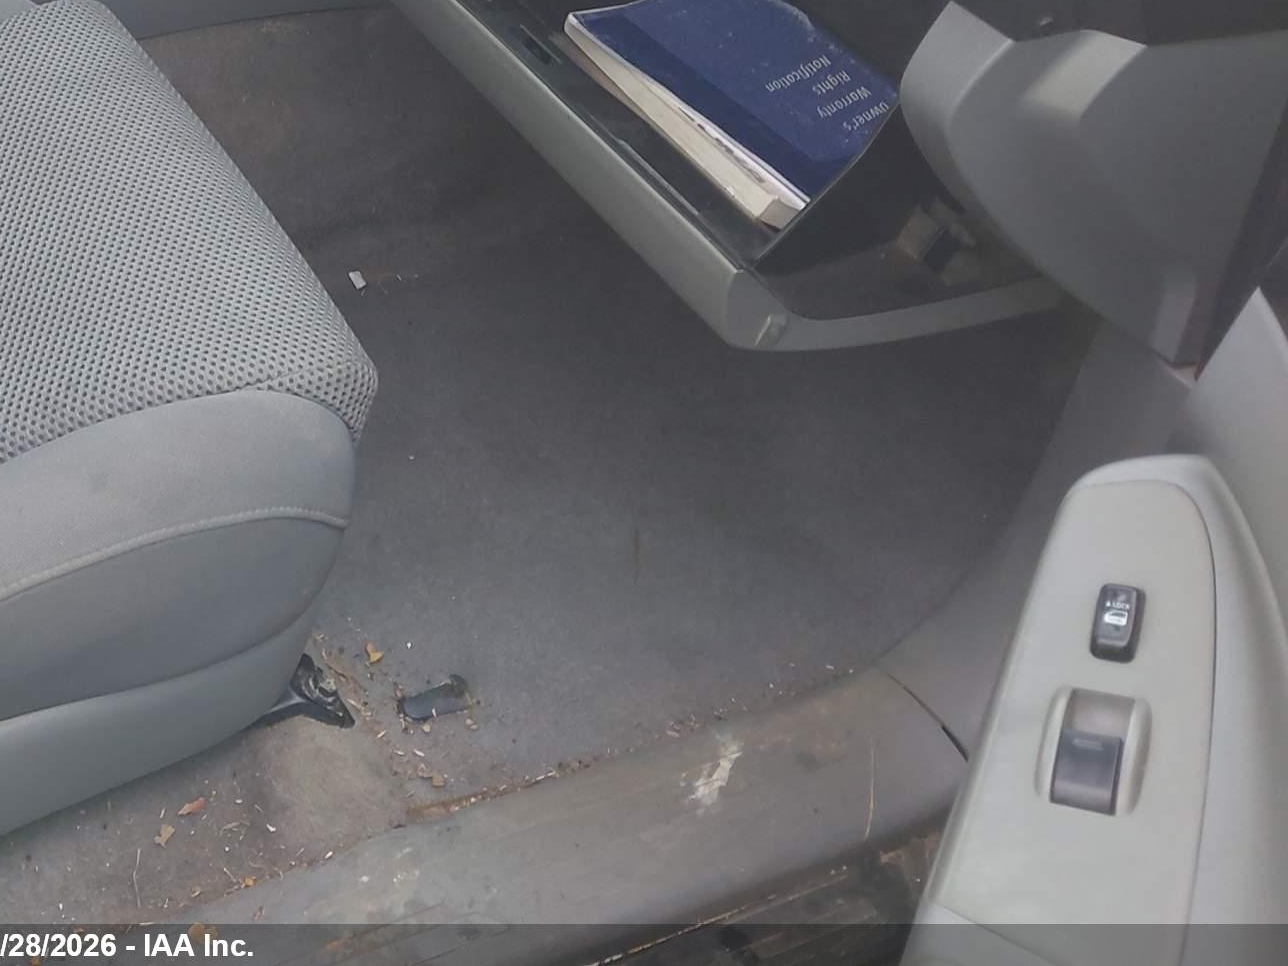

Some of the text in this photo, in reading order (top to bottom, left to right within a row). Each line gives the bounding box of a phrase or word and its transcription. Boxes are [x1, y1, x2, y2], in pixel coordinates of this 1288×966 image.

[765, 55, 831, 92] Notification
[812, 70, 851, 95] Rights
[816, 86, 872, 118] Warranty
[1112, 601, 1130, 610] LOCK
